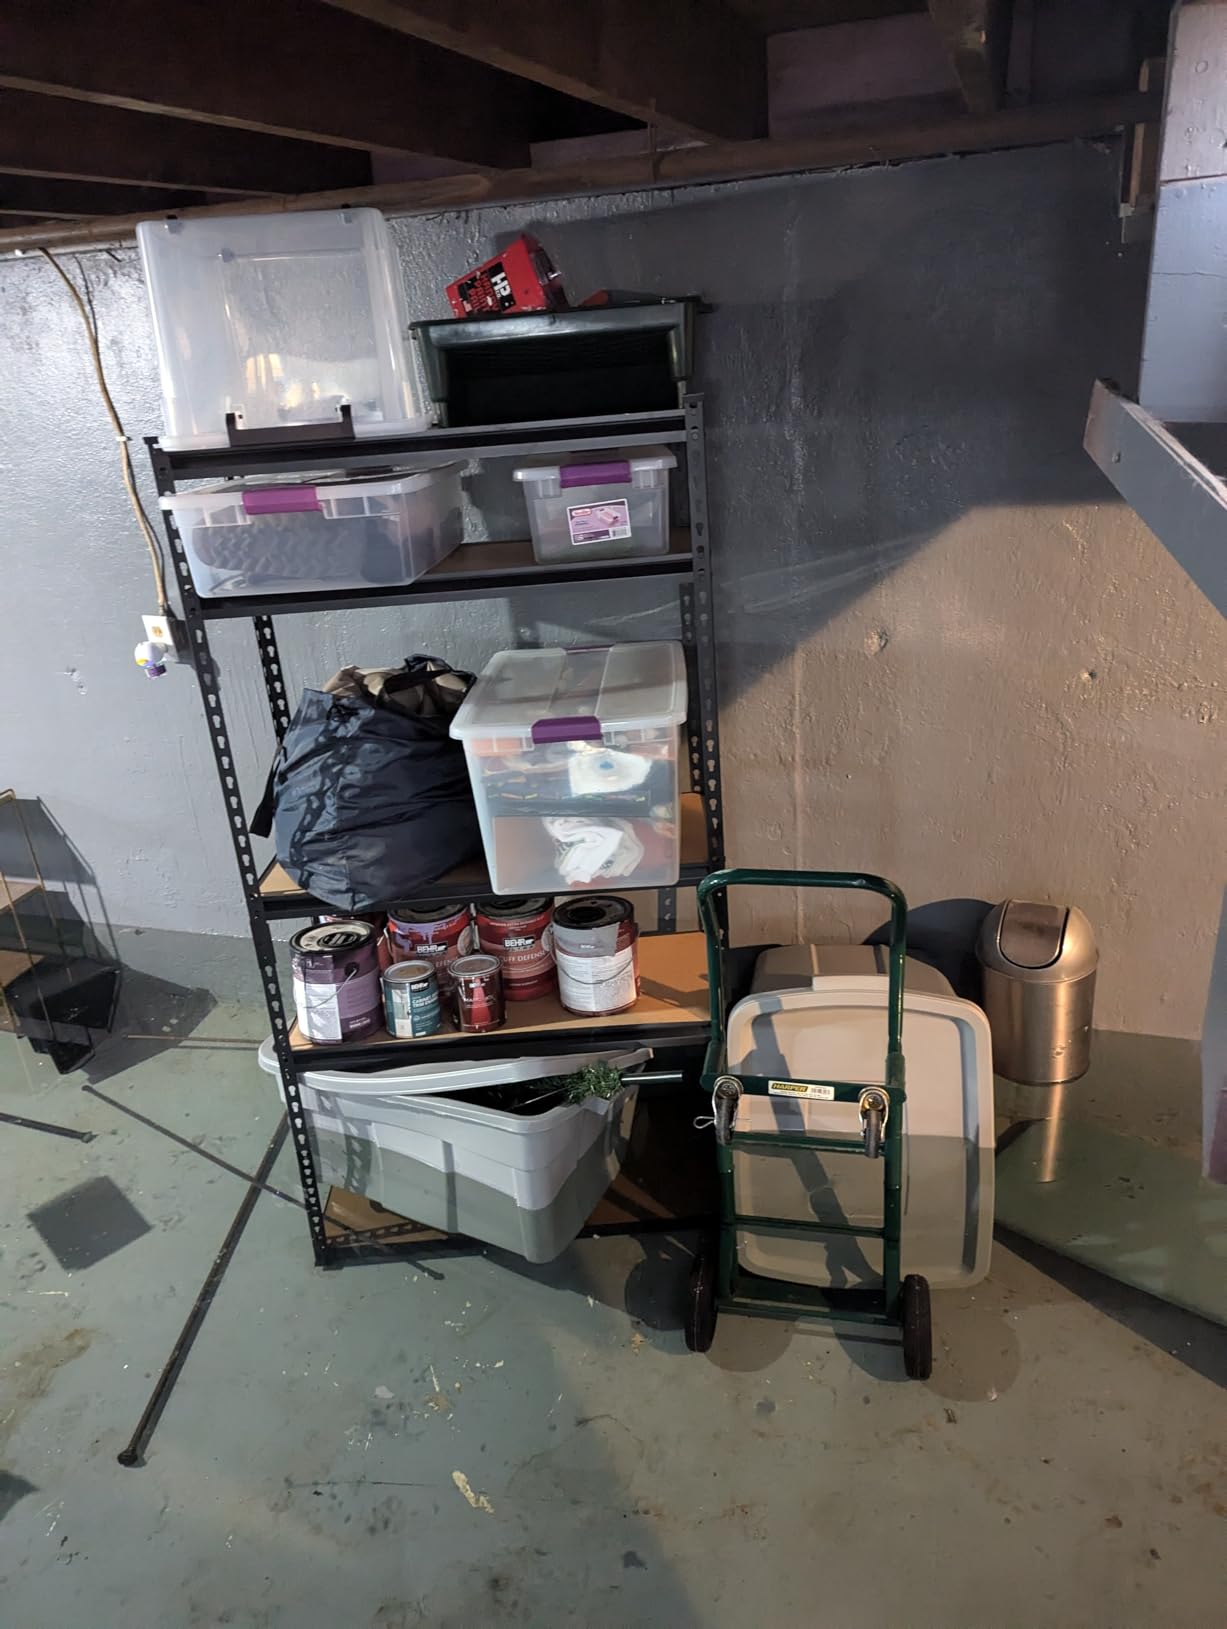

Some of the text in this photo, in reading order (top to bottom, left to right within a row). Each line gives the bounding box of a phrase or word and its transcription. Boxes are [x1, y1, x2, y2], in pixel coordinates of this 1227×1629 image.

[504, 938, 525, 947] BEHR
[416, 944, 438, 954] BEHR
[773, 1083, 807, 1092] HARPER
